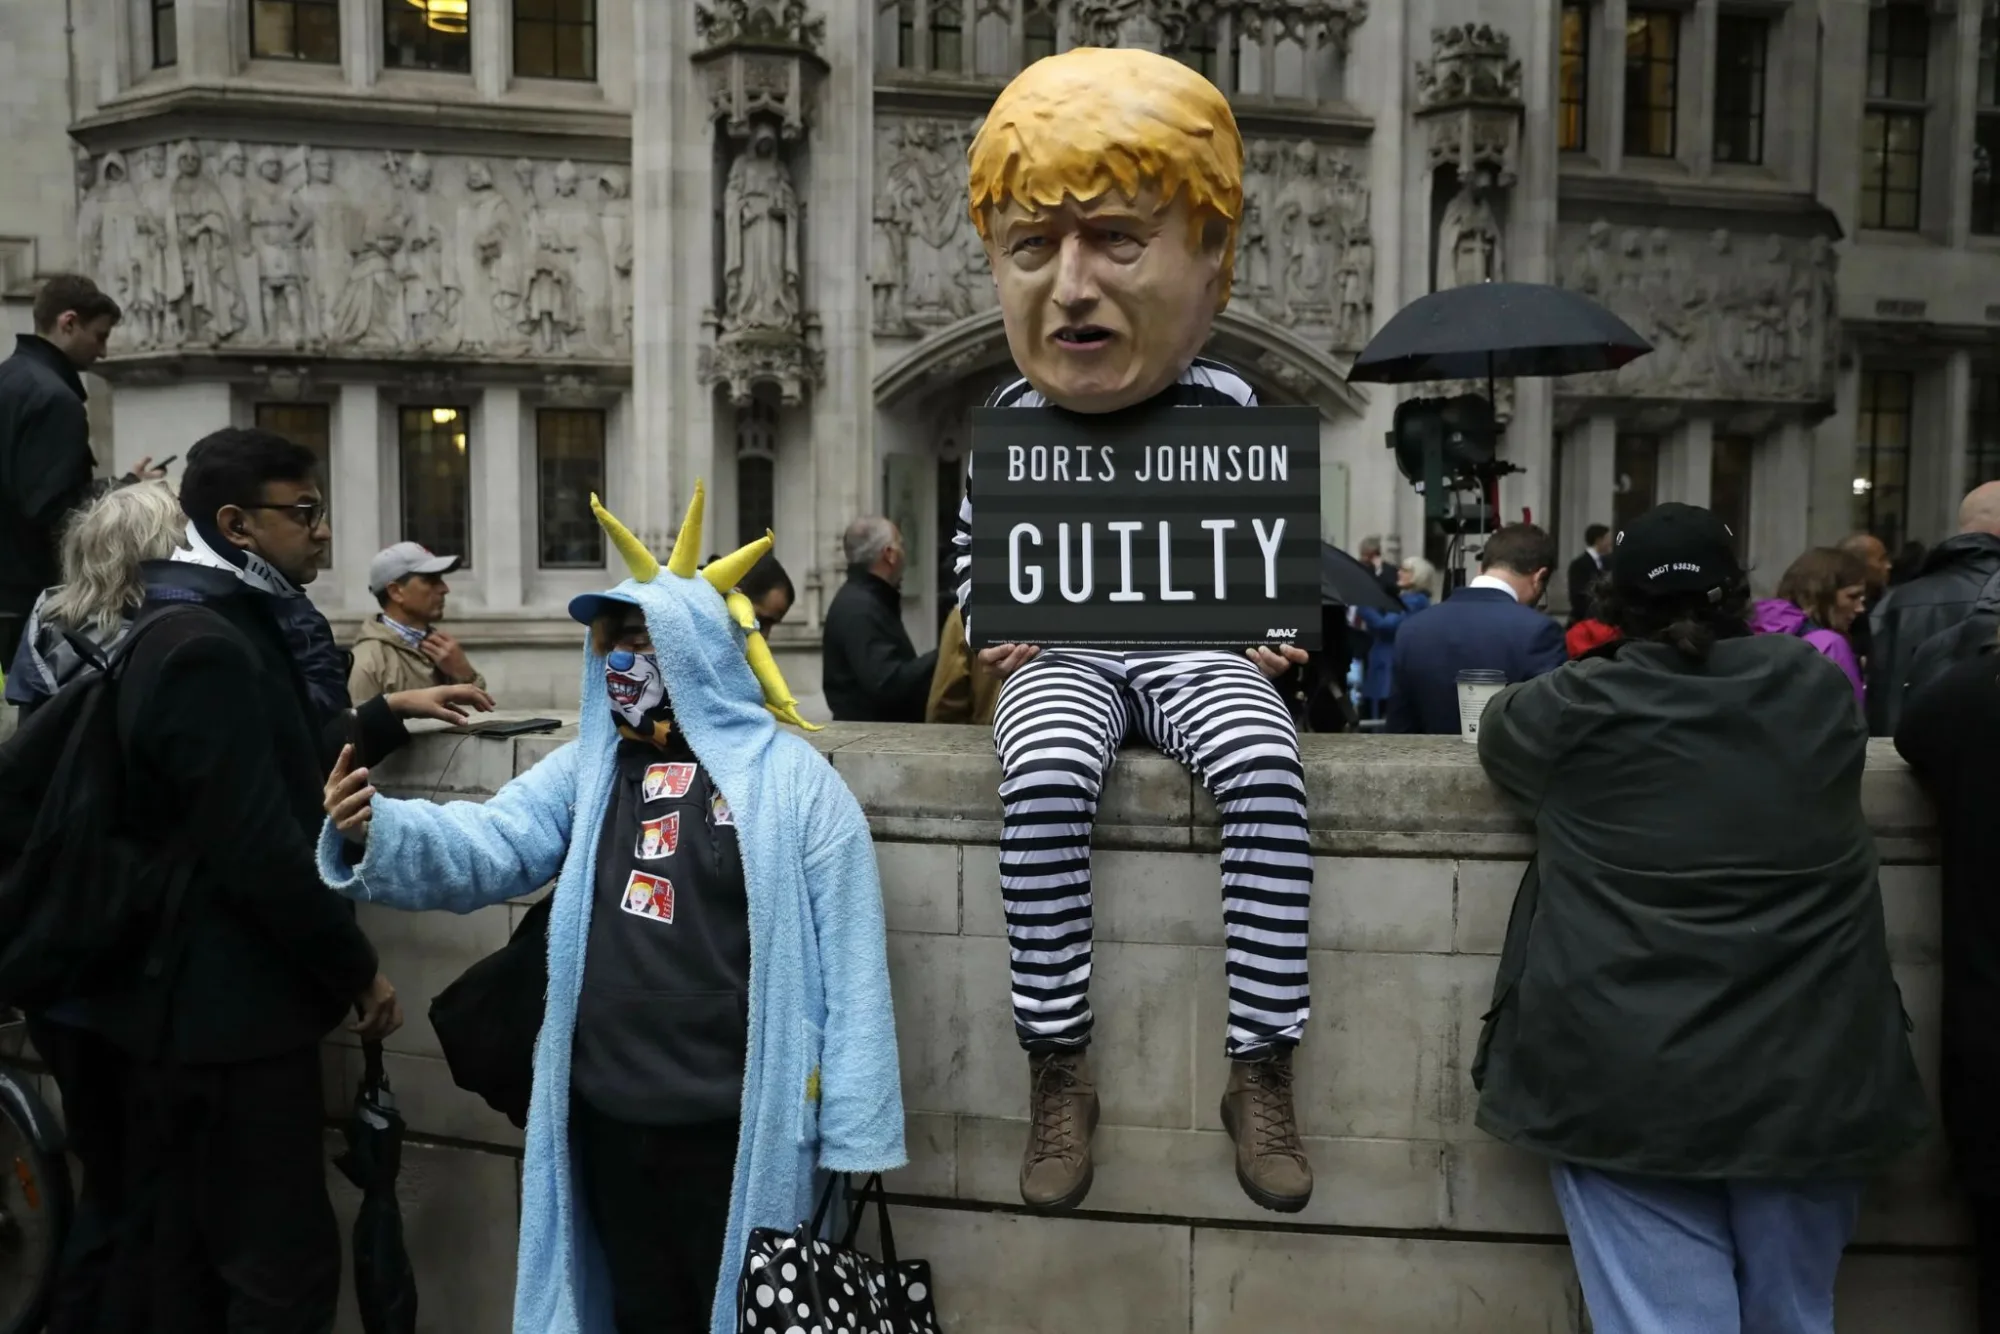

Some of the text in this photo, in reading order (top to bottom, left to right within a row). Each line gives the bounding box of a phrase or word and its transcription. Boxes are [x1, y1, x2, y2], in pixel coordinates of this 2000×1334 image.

[1007, 445, 1289, 482] BORIS JOHNSON
[1008, 517, 1287, 604] GUILTY
[1265, 628, 1299, 638] AVAAZ
